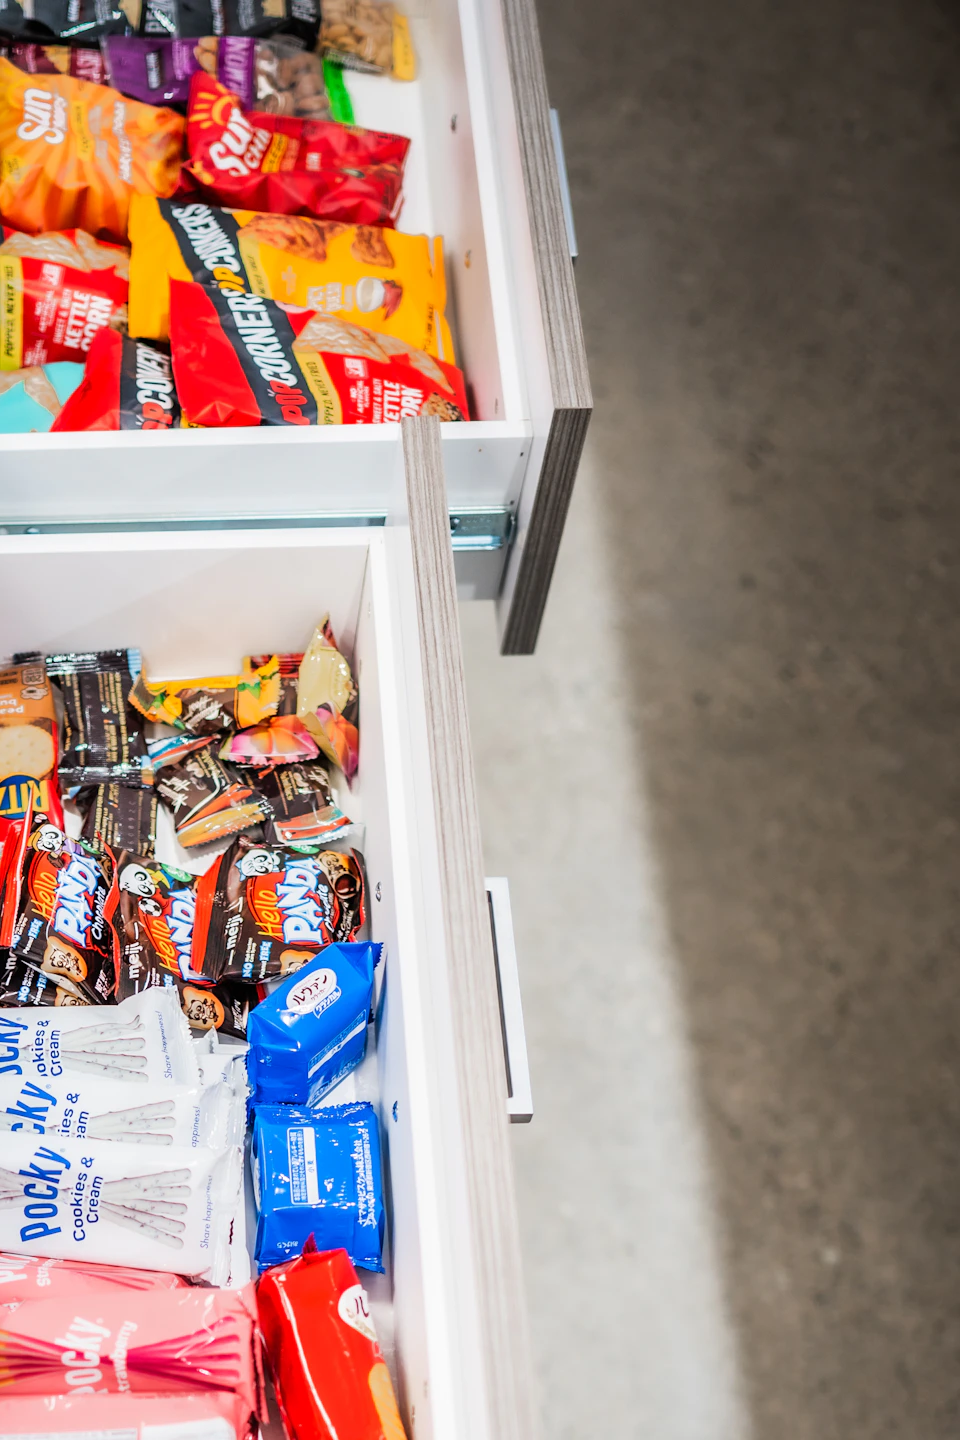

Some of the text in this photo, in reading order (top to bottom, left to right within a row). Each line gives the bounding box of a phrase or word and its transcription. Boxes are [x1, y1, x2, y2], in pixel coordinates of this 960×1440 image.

[172, 204, 247, 294] OPCORNERS
[63, 291, 92, 349] KETTLE
[401, 384, 425, 417] ORN
[31, 871, 58, 920] Hello
[53, 852, 102, 949] PANDA
[255, 889, 281, 937] Hello
[275, 856, 325, 945] PANDA
[22, 918, 44, 954] Peanut FREE
[155, 918, 172, 973] Hello
[225, 915, 244, 950] meiji
[125, 941, 143, 979] meiji
[243, 961, 253, 979] NO
[259, 940, 272, 979] Peanut FREE
[17, 985, 31, 1003] NO
[292, 974, 328, 1005] ルヴァン
[37, 1019, 50, 1027] &
[50, 1029, 63, 1077] Cream
[164, 1053, 173, 1079] Share
[6, 1081, 58, 1135] cky
[77, 1110, 90, 1138] eam
[191, 1105, 201, 1148] appiness!
[18, 1145, 72, 1243] Pocky
[73, 1156, 96, 1242] Cookies &
[86, 1175, 104, 1224] Cream
[200, 1175, 213, 1250] Share happiness!
